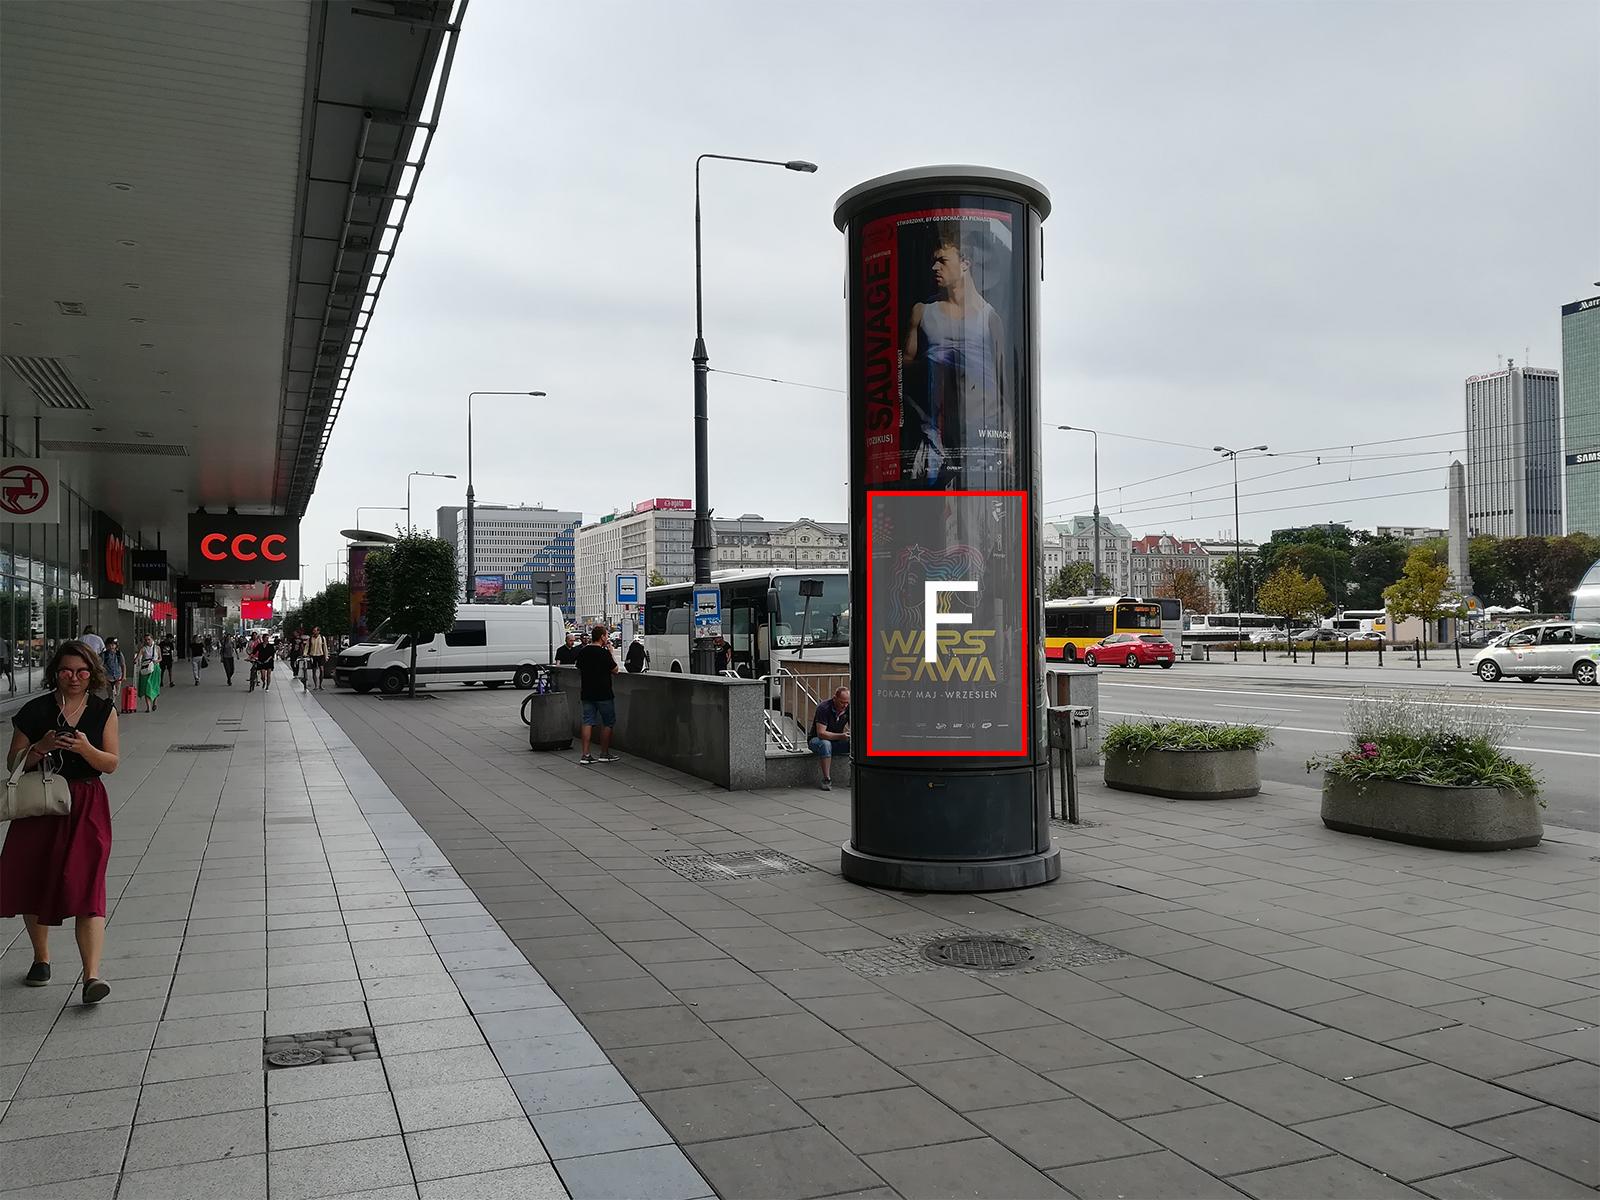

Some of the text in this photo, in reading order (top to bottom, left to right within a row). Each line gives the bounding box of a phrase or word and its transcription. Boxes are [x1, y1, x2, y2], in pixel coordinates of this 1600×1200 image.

[866, 257, 893, 431] SAUVAGE
[978, 429, 986, 438] W
[200, 532, 287, 562] CCC
[877, 689, 912, 698] POKAZY
[915, 690, 937, 699] MAJ
